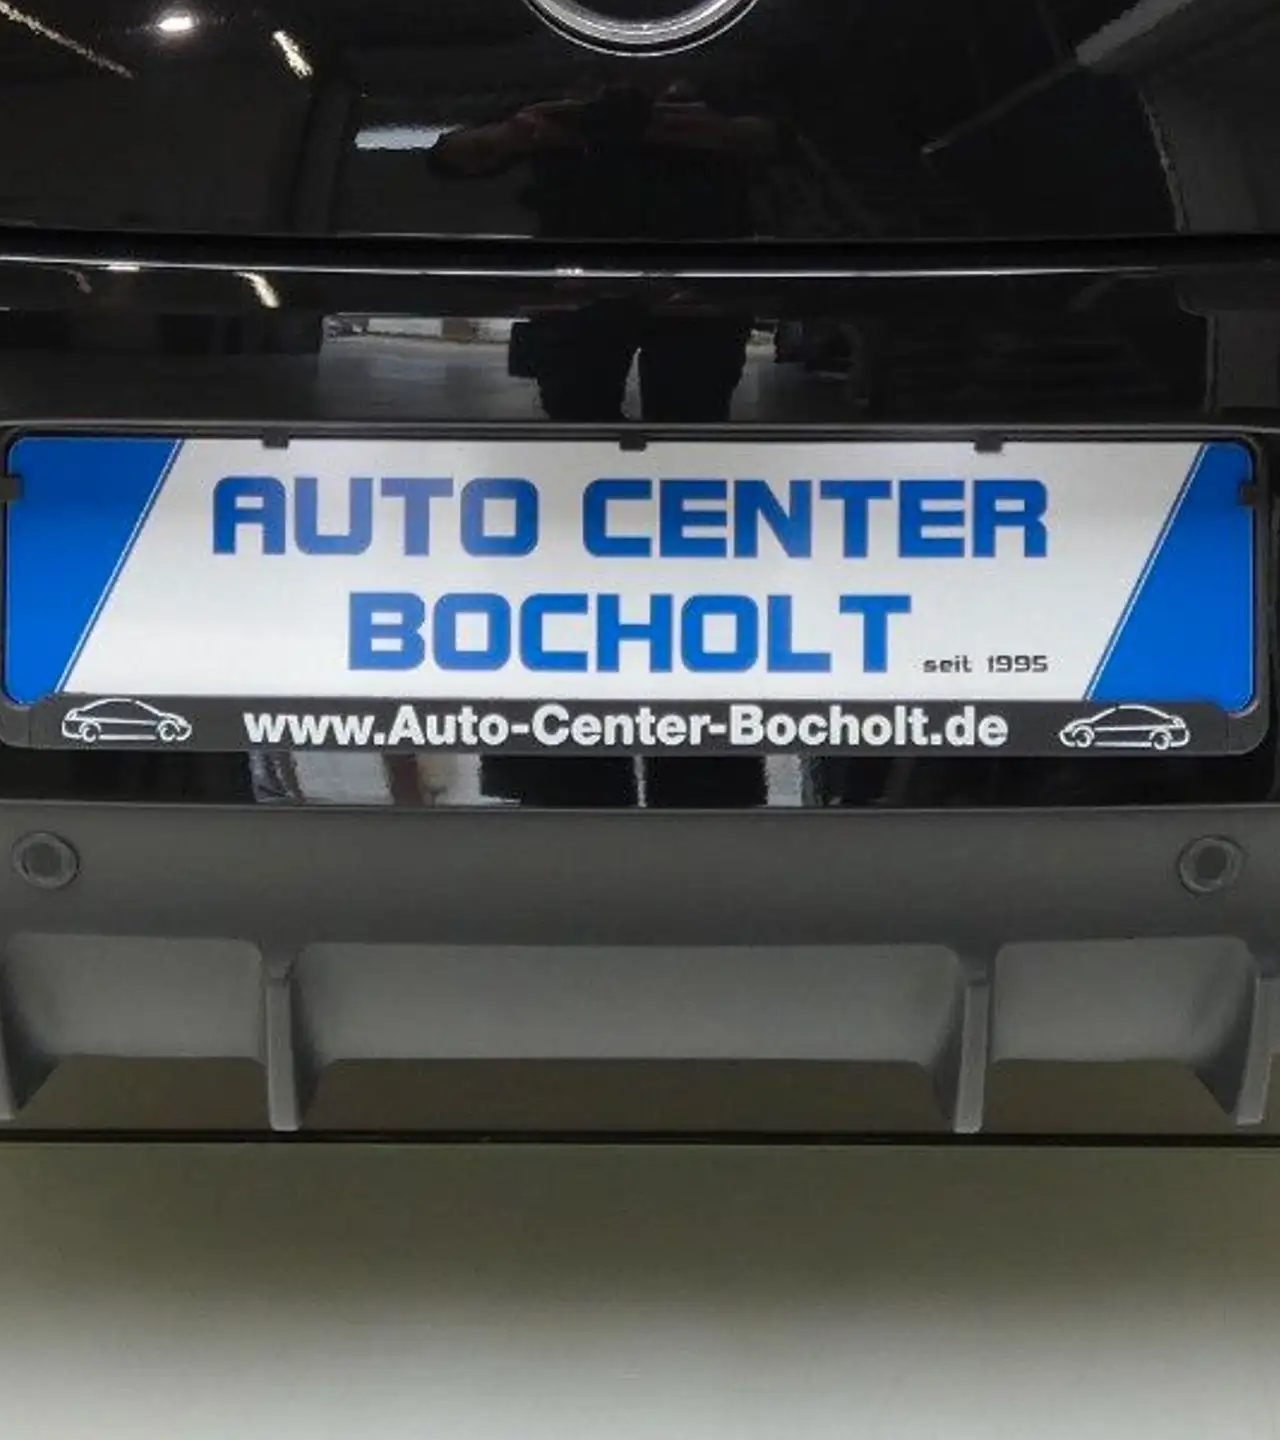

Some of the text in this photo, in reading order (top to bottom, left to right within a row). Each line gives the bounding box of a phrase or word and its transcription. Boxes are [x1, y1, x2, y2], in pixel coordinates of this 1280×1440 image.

[212, 477, 1048, 558] AUTO CENTER
[351, 592, 911, 672] BOCHOLT
[922, 654, 1049, 674] seit 1995
[243, 703, 1010, 750] www.Auto-Center-Bocholt.de
